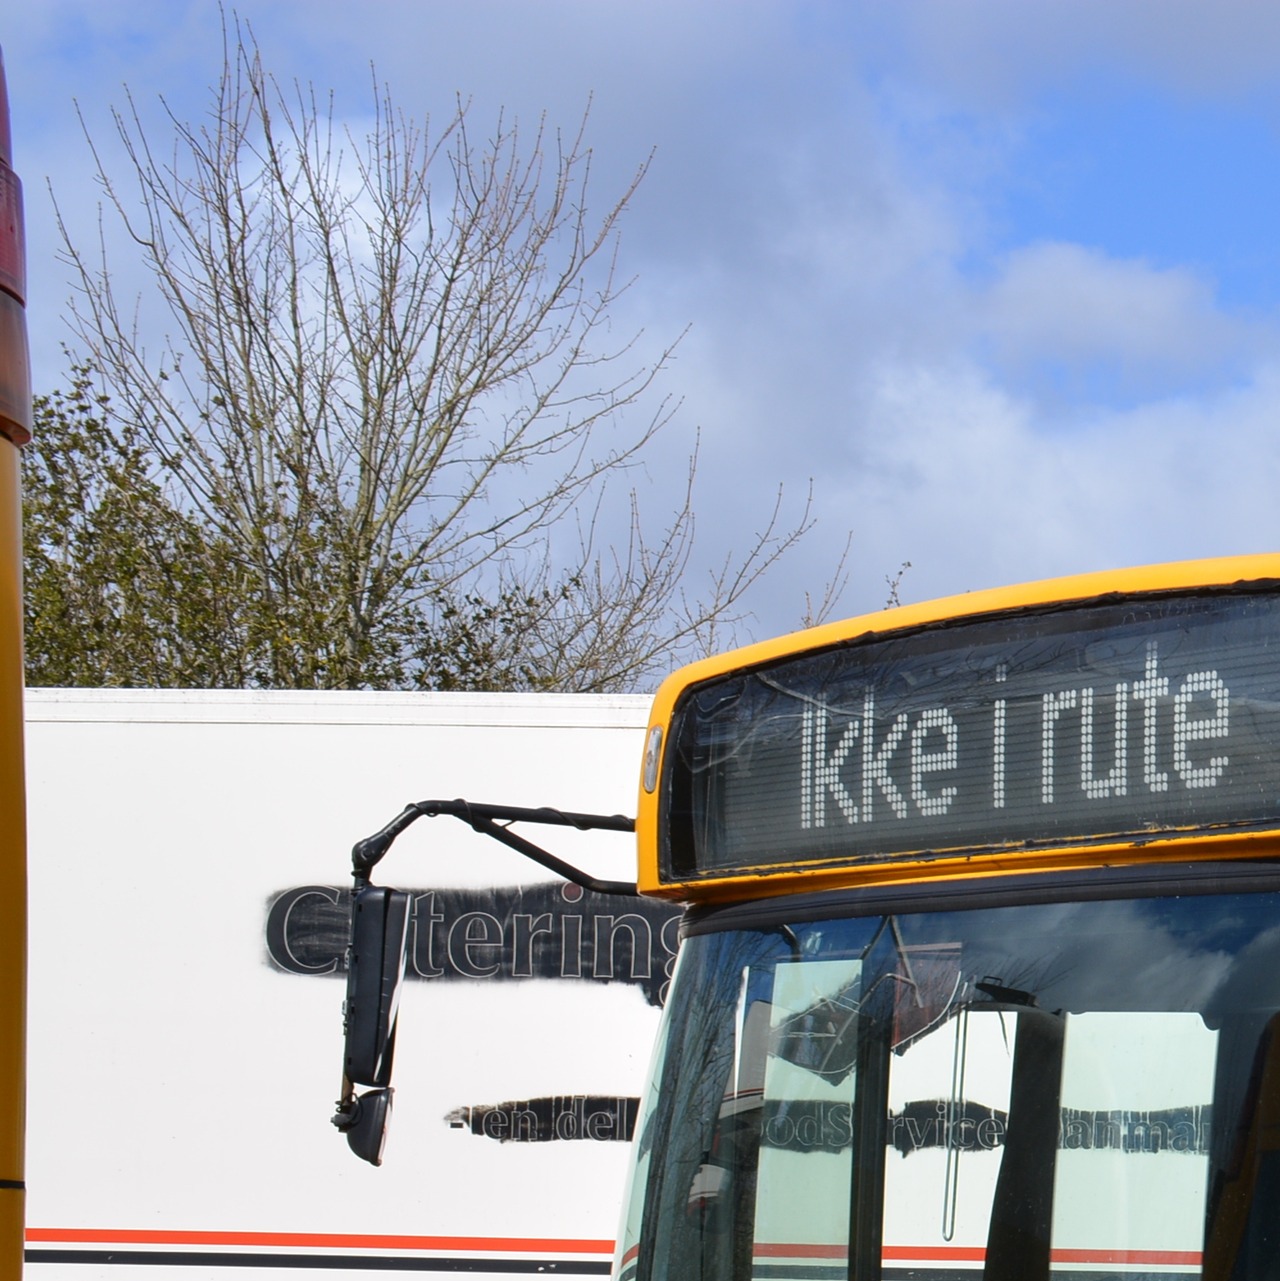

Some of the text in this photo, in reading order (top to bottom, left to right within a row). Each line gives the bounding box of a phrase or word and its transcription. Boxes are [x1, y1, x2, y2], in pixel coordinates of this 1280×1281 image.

[994, 665, 1006, 808] i
[1042, 642, 1230, 804] rute
[266, 882, 684, 1004] Cterin
[482, 1109, 538, 1142] en
[556, 1096, 628, 1141] del
